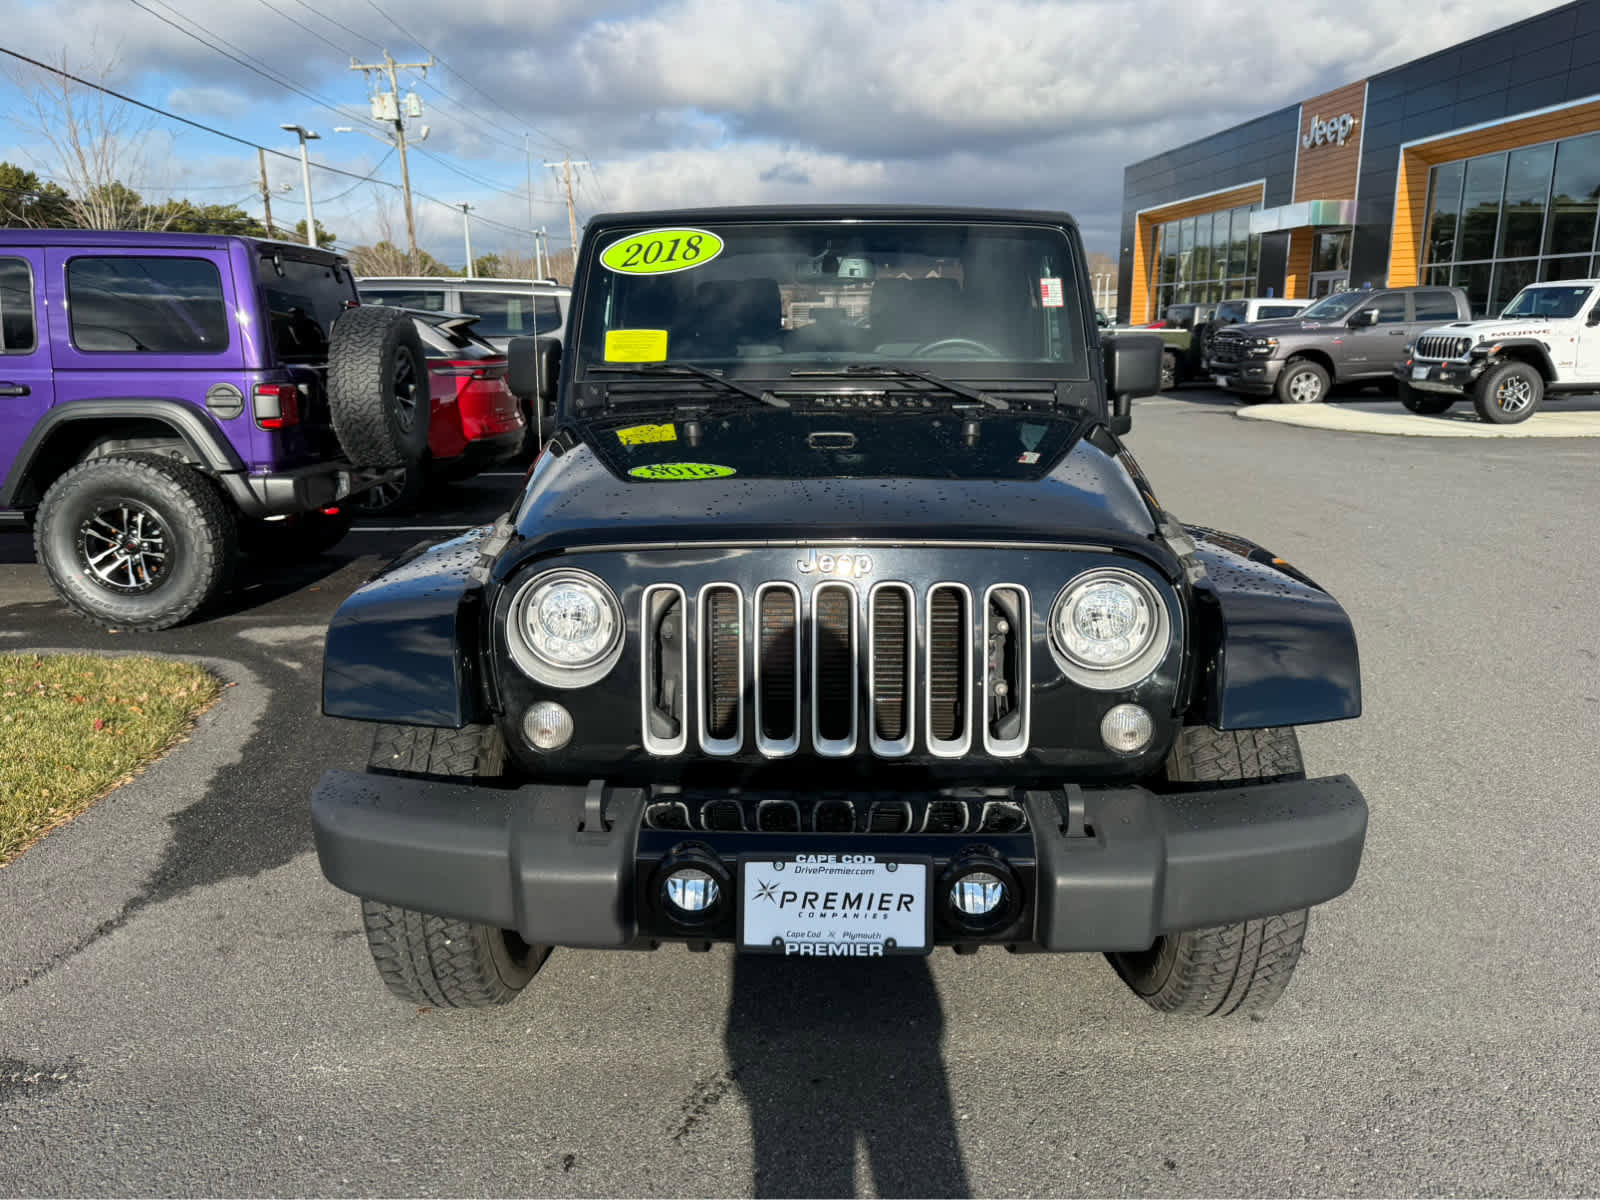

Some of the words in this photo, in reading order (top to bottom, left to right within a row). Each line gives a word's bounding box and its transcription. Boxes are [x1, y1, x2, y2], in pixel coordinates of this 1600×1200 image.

[1303, 113, 1354, 149] Jeep
[621, 235, 703, 268] 2018
[797, 548, 873, 578] Jeep
[795, 854, 837, 864] CAPE
[841, 855, 876, 864] COD
[794, 866, 875, 876] DrivePremier.com
[779, 891, 915, 912] PREMIER
[798, 911, 888, 919] COMPANIES
[786, 930, 805, 939] Cape
[806, 930, 821, 938] Cod
[842, 931, 882, 940] Plymouth
[785, 943, 883, 956] PREMIER
